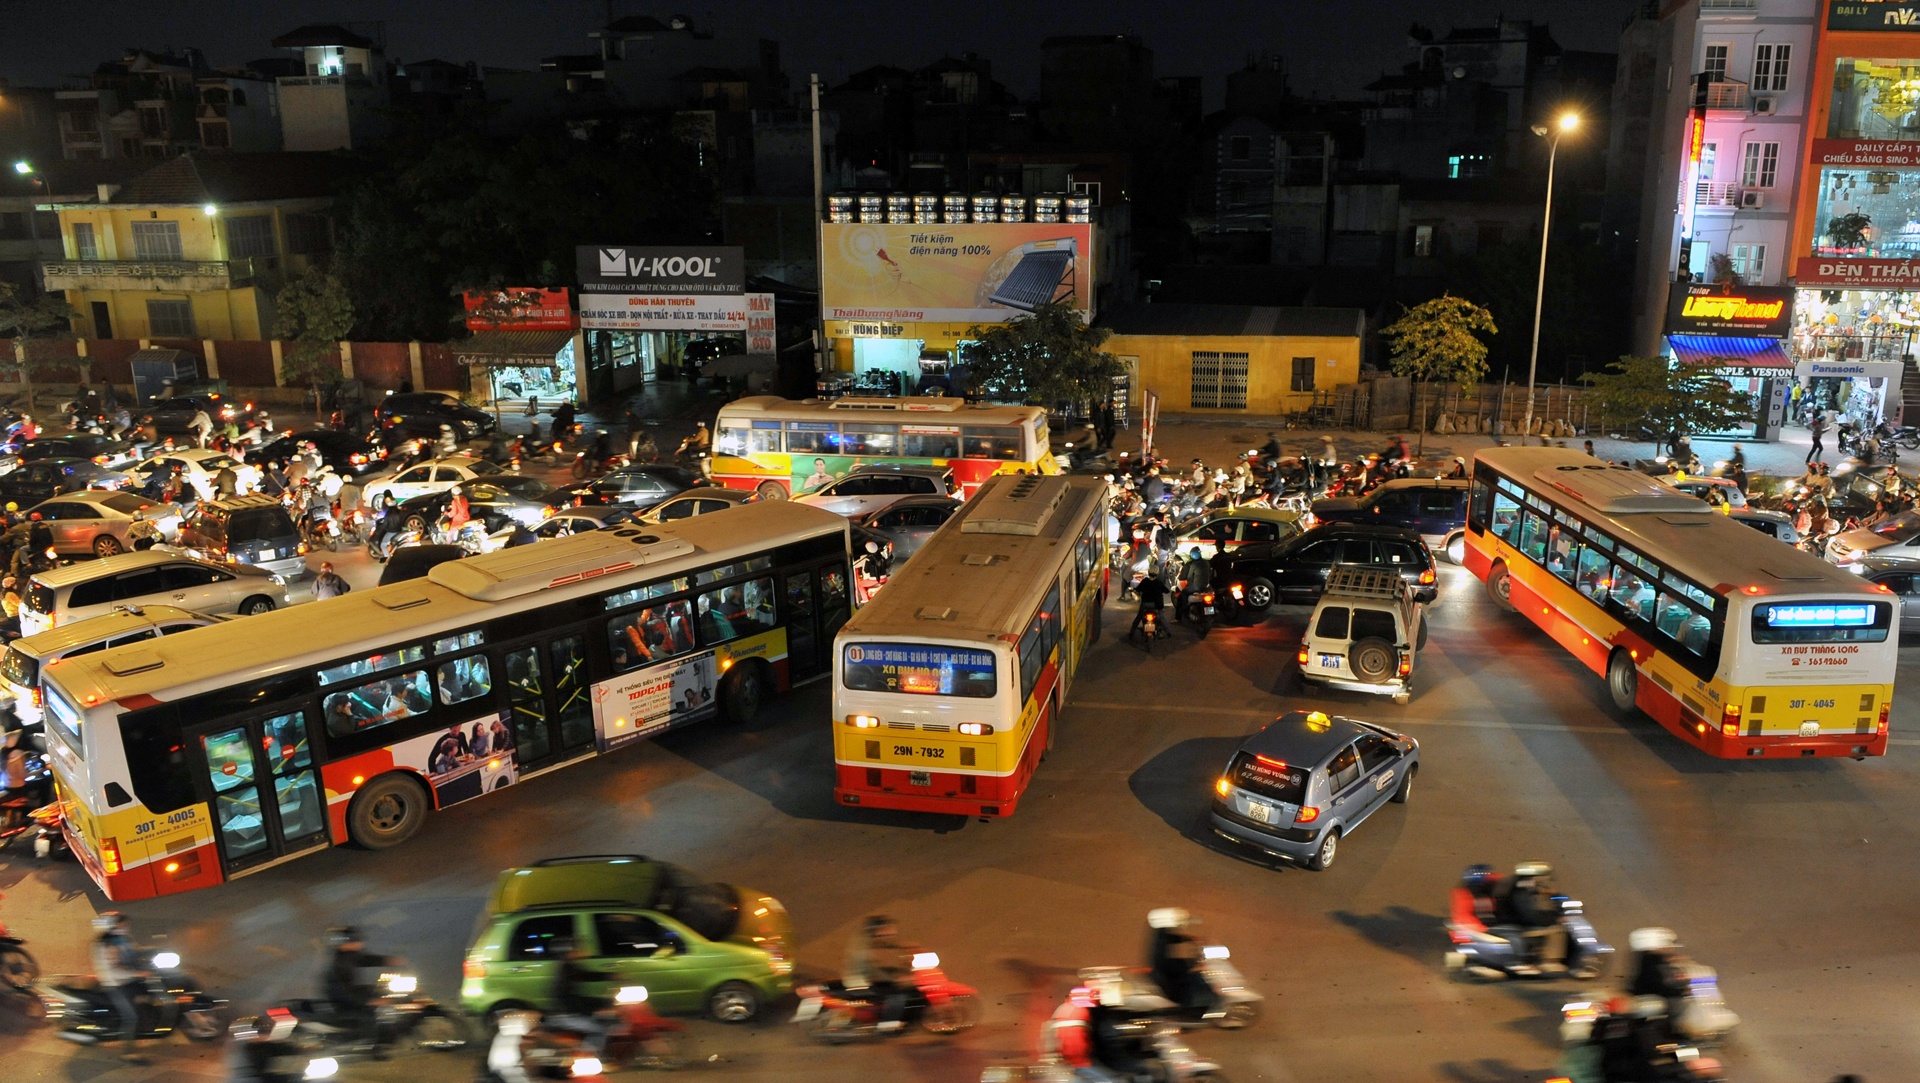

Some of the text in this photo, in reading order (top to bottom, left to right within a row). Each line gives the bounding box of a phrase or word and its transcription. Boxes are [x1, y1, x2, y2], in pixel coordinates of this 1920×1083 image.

[1837, 6, 1853, 16] ĐẠI
[1855, 143, 1873, 154] ĐẠI
[1873, 142, 1885, 153] LÝ
[1886, 142, 1906, 153] CẤP
[1823, 151, 1908, 164] CHIẾU SÁNG SINO
[910, 234, 954, 246] Tiết kiệm
[910, 245, 991, 257] điện năng 100%
[628, 256, 717, 277] V-KOOL
[1819, 261, 1862, 276] ĐÈN
[1688, 286, 1711, 295] Tailor
[628, 297, 649, 306] DŨNG
[667, 297, 695, 306] THUYÊN
[749, 295, 772, 311] MÁY
[654, 308, 669, 320] THẤT
[698, 312, 713, 320] THAY
[727, 311, 746, 321] 24/24
[748, 317, 775, 333] LẠNH
[853, 324, 879, 335] HÙNG
[1751, 367, 1793, 377] VESTON
[1812, 364, 1865, 374] Panasonic
[850, 648, 863, 660] 01
[1794, 646, 1809, 655] BUS
[1810, 645, 1836, 654] THĂNG
[1838, 646, 1859, 654] LONG
[897, 665, 915, 675] BUS
[1789, 699, 1835, 709] 30T 4045
[893, 745, 945, 758] 29N 7932
[1245, 763, 1257, 771] TAXI
[135, 808, 196, 835] 30T 4005
